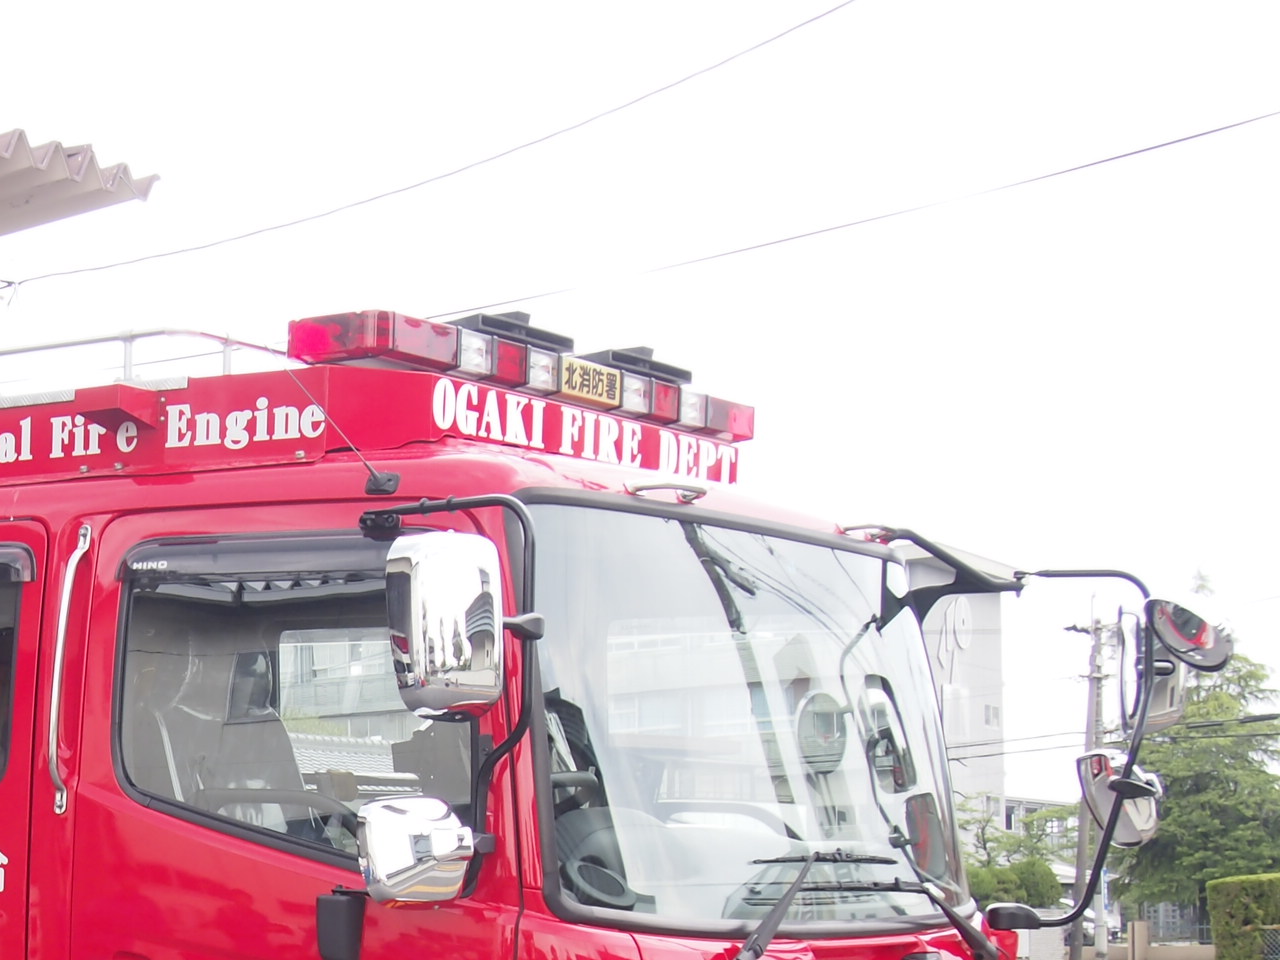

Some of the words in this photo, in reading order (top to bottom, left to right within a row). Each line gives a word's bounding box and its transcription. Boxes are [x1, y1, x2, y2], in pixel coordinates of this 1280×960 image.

[564, 362, 618, 400] 北消防署
[49, 416, 138, 457] Fire
[164, 396, 327, 450] Engine
[431, 377, 547, 449] OGAKI
[558, 405, 643, 469] FIRE
[132, 560, 168, 570] HINO
